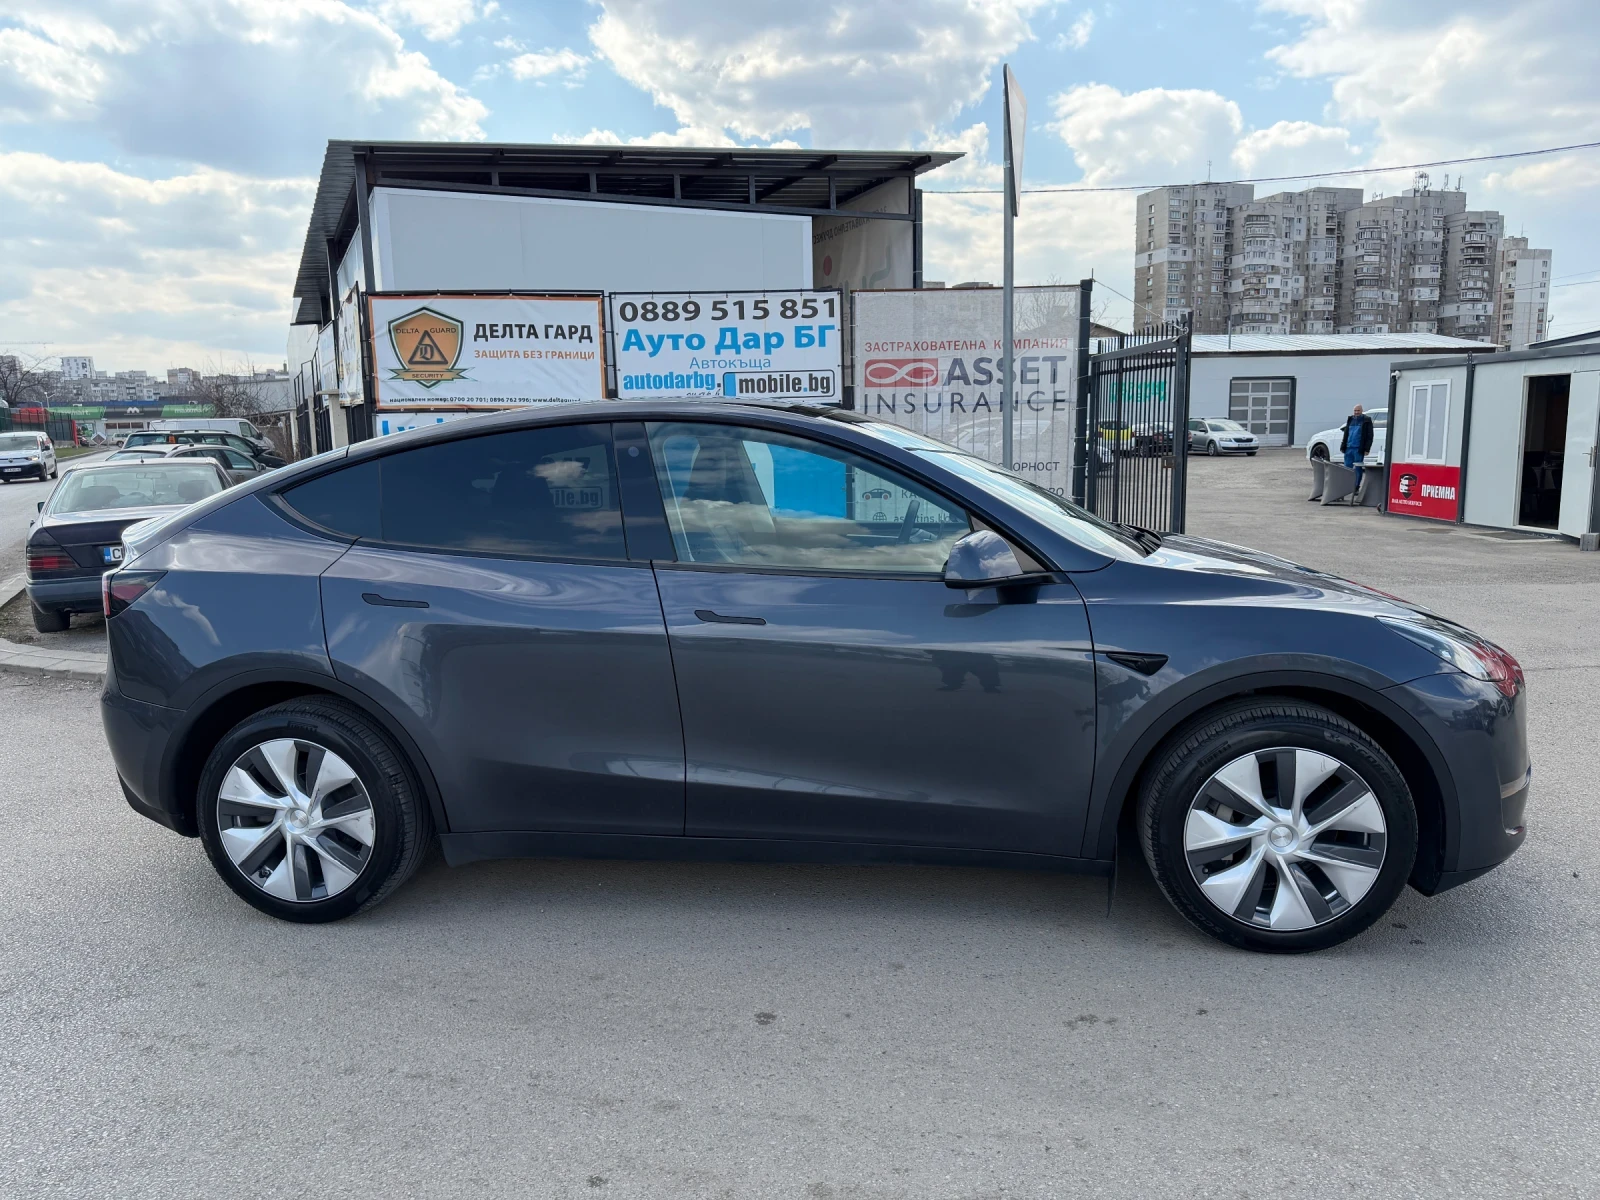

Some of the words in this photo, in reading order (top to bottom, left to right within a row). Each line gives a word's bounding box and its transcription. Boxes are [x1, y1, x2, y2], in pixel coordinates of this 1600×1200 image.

[619, 300, 701, 322] 0889
[711, 299, 770, 320] 515
[779, 297, 836, 320] 851
[473, 323, 540, 342] ДЕЛТА
[544, 324, 593, 343] ГАРД
[622, 328, 706, 358] Ауто
[714, 327, 785, 355] Дар
[794, 324, 835, 348] БГ
[474, 350, 520, 360] ЗАЩИТА
[523, 350, 543, 359] БЕЗ
[545, 351, 595, 361] ГРАНИЦИ
[864, 340, 987, 353] ЗАСТРАХОВАТЕЛНА
[993, 338, 1068, 350] КМПАНИЯ
[689, 357, 771, 370] Автокъща
[943, 355, 1067, 387] ASSET
[738, 373, 831, 394] mobile.bg
[864, 390, 1066, 415] INSURANCE
[997, 461, 1060, 472] ОРНОСТ
[1421, 484, 1456, 500] ПРИЕМНА
